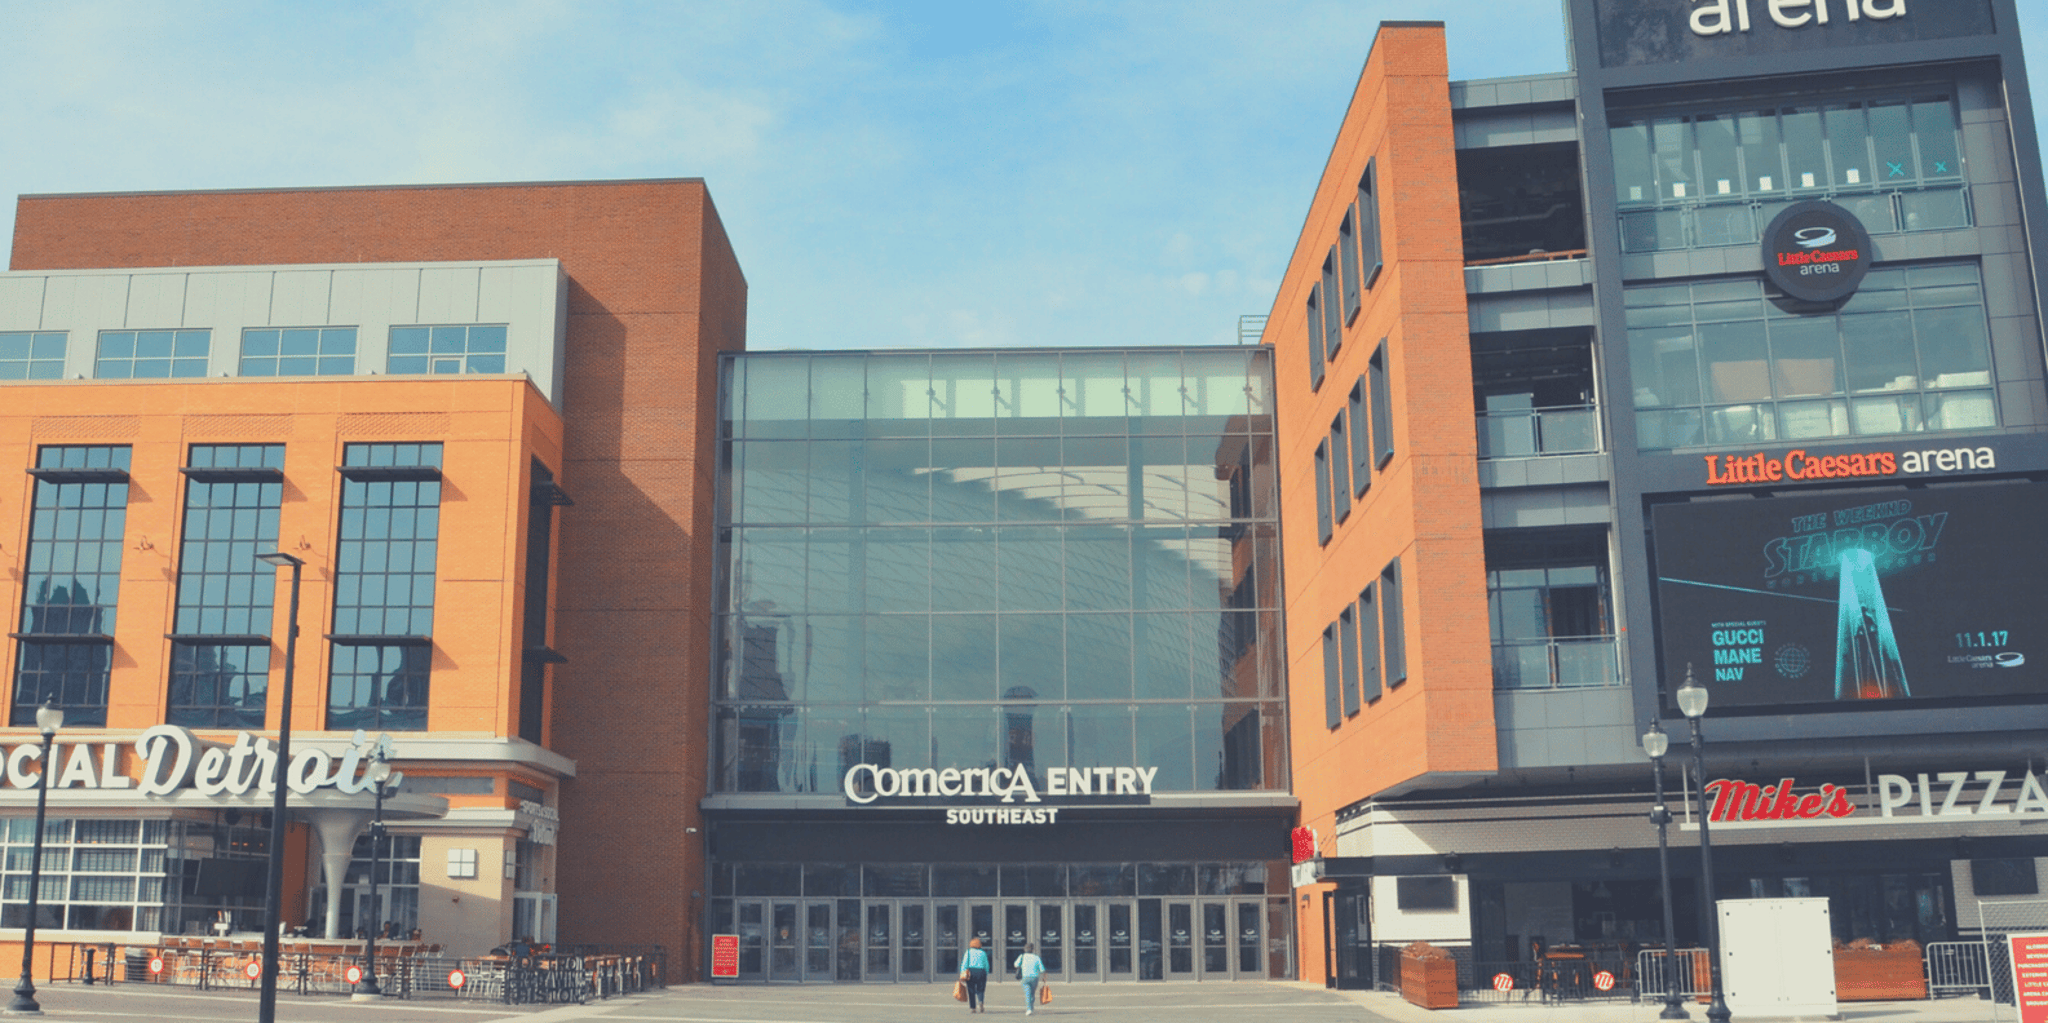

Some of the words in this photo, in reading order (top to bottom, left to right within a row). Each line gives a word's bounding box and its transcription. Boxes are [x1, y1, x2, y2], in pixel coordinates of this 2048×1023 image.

[1800, 262, 1840, 276] arena
[1704, 452, 1783, 485] Little
[1785, 449, 1897, 480] Caesars
[1902, 446, 1996, 474] arena
[1791, 512, 1828, 533] THE
[1712, 628, 1764, 646] GUCCI
[1956, 630, 2008, 648] 11.1.17
[1713, 647, 1762, 665] MANE
[1715, 667, 1744, 681] NAV
[0, 743, 130, 789] CIAL
[1047, 766, 1158, 795] ENTRY
[1704, 777, 1857, 822] Mike's
[1878, 769, 2048, 818] PIZZA
[946, 808, 1059, 825] SOUTHEAST
